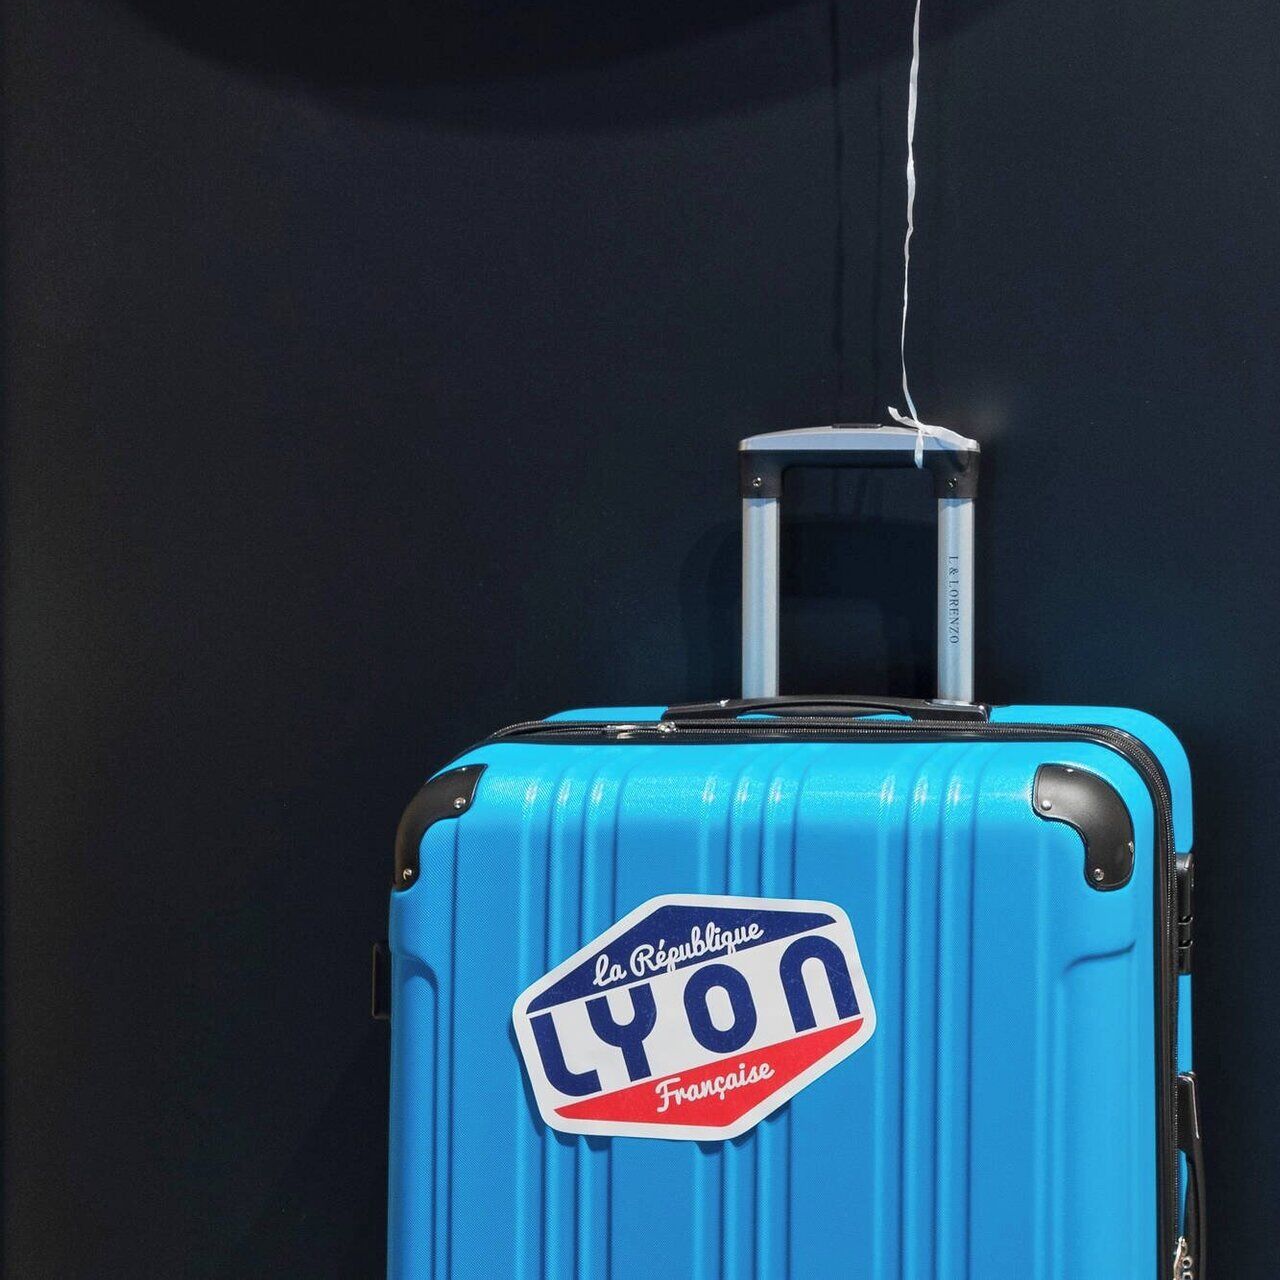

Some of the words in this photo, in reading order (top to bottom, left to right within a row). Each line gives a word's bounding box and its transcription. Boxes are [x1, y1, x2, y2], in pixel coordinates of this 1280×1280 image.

[949, 580, 959, 644] LORENZO
[630, 921, 764, 978] République
[654, 1059, 775, 1113] Française
